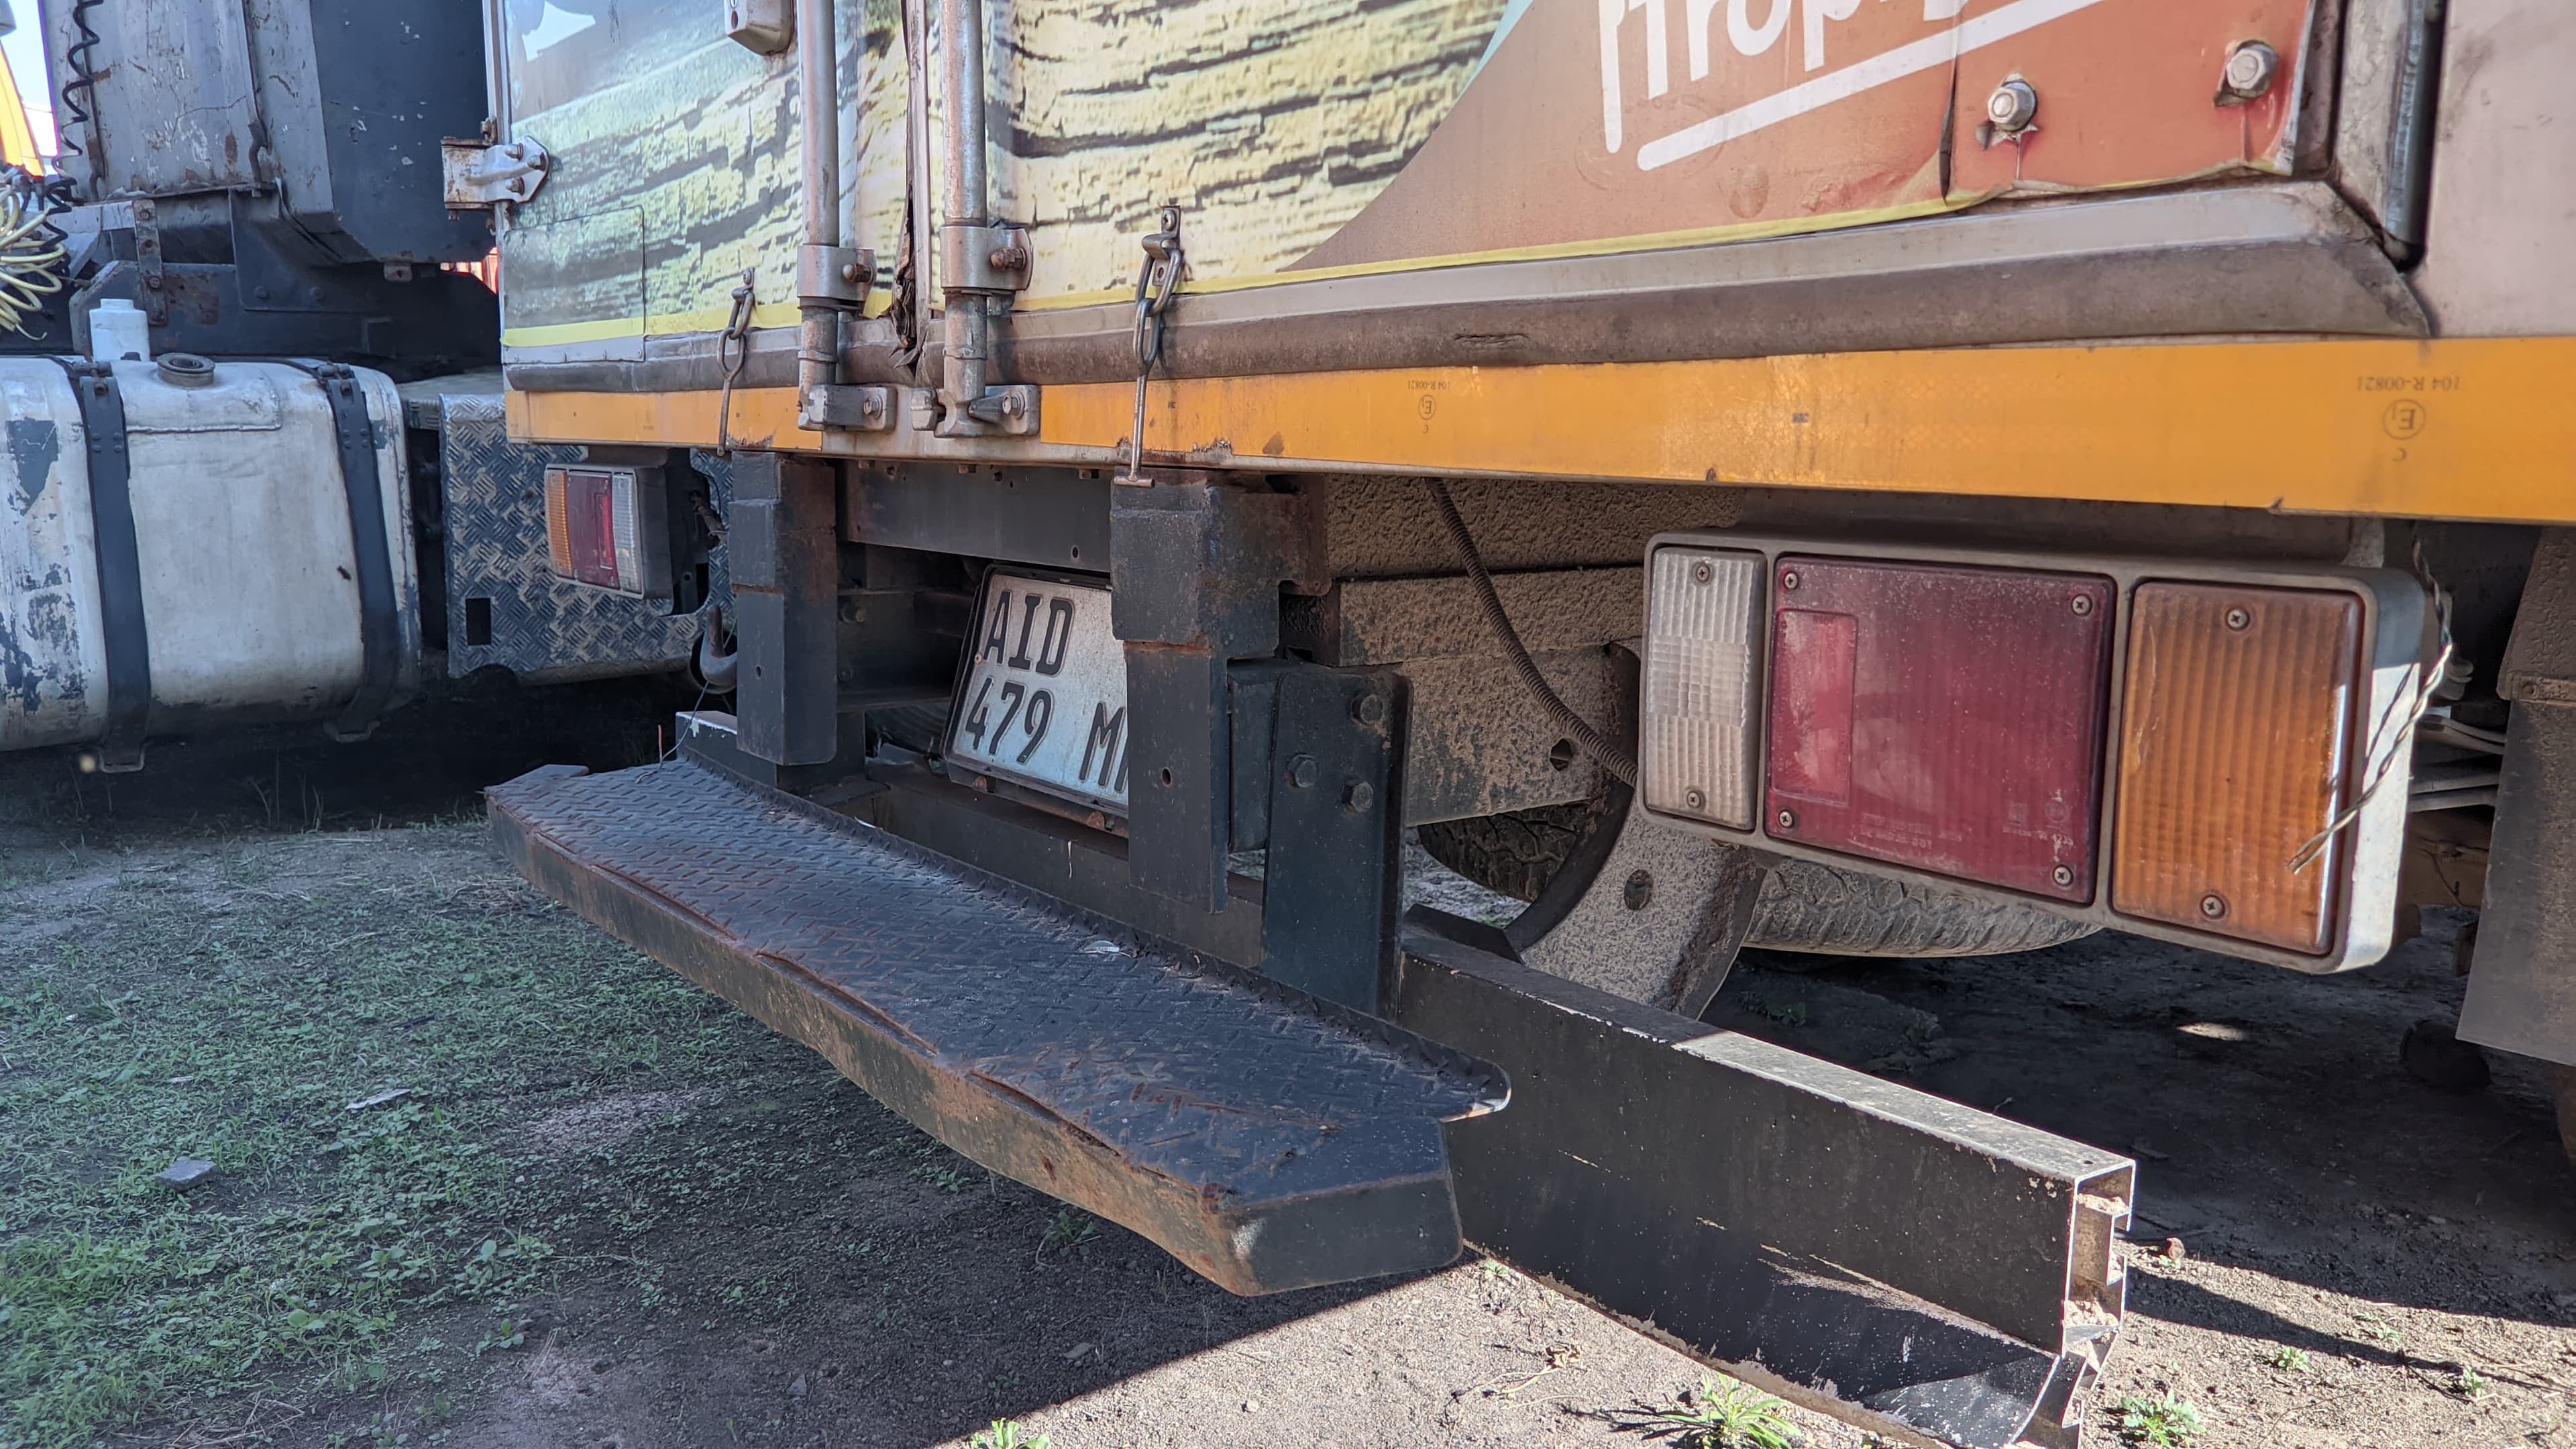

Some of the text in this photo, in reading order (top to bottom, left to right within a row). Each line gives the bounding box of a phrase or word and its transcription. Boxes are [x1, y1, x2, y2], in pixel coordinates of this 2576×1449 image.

[2432, 376, 2460, 390] 104
[983, 590, 1075, 676] AID
[965, 677, 1128, 792] 479 M
